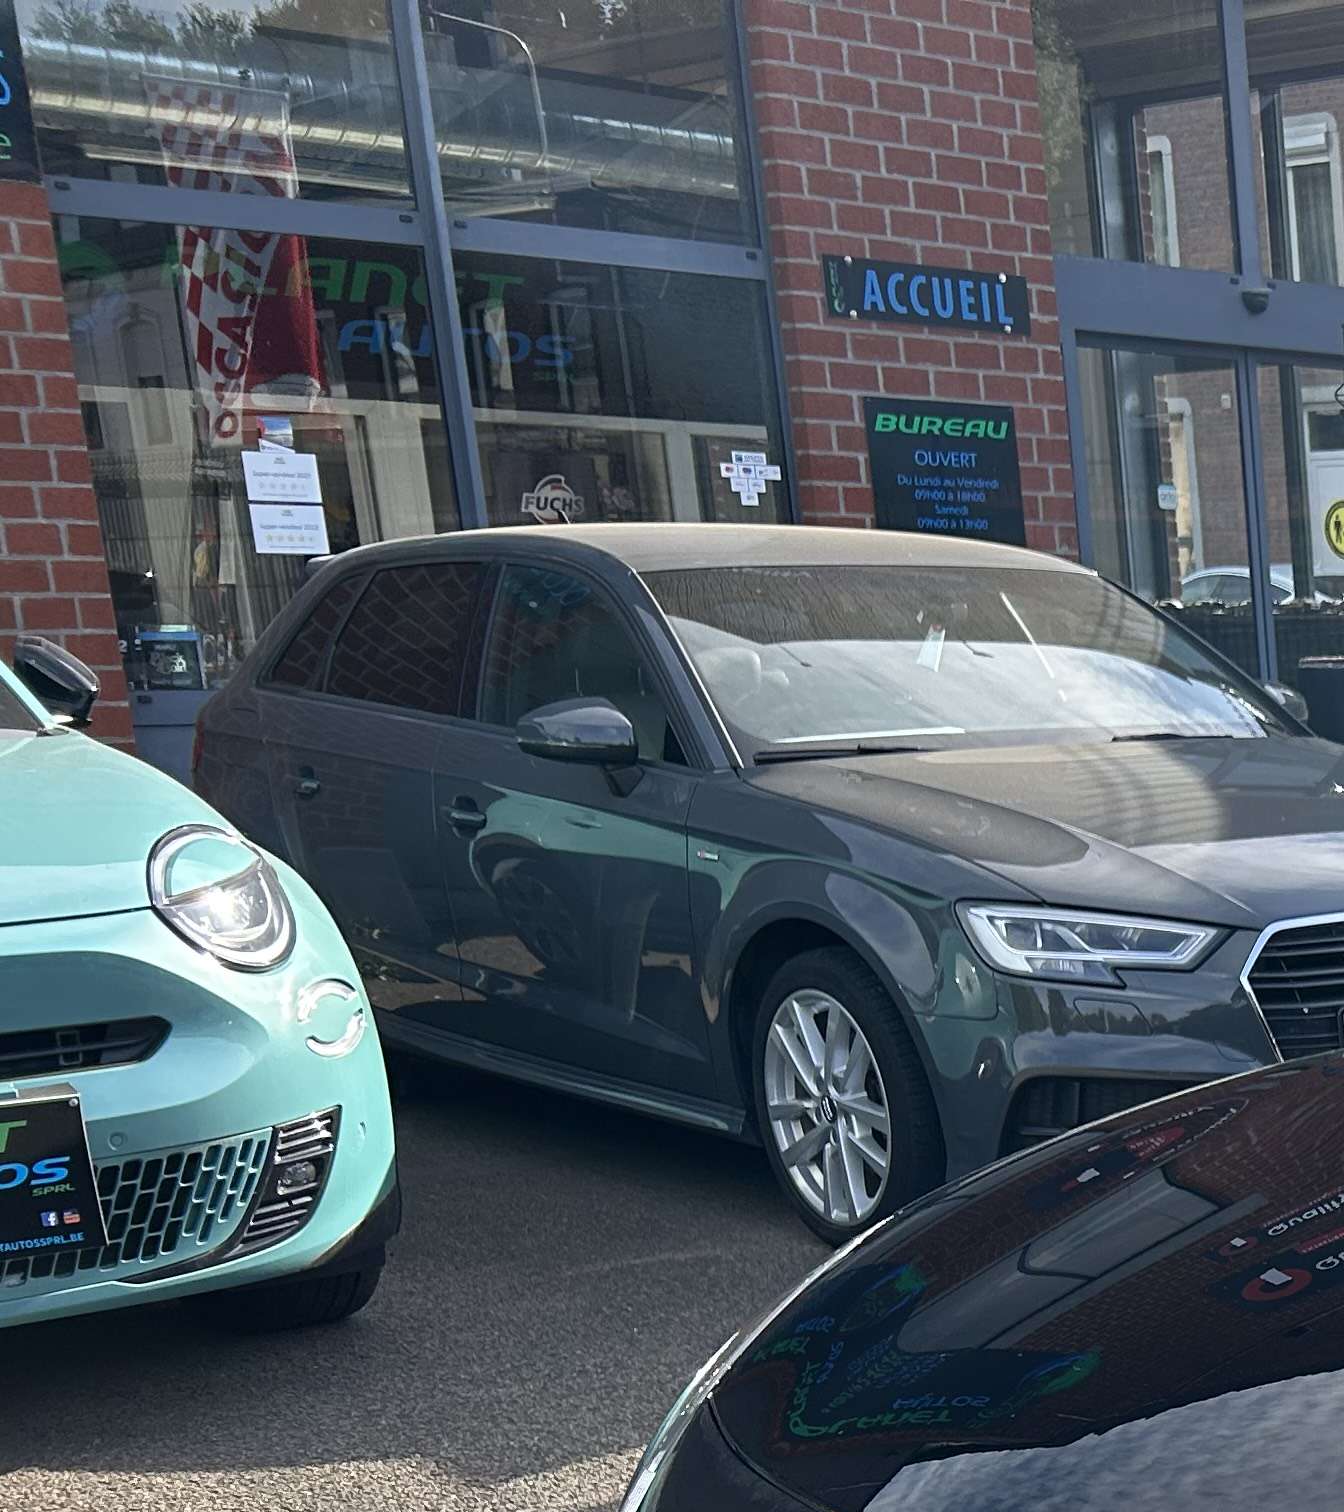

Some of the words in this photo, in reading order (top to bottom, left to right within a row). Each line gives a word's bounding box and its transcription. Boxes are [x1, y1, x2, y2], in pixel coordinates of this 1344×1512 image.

[863, 269, 1014, 325] ACCUEIL
[874, 413, 1009, 440] BUREAU
[914, 450, 978, 468] OUVERT
[897, 474, 912, 486] Du
[914, 475, 942, 487] Lundi
[943, 478, 956, 488] au
[957, 477, 1000, 490] Vendredi
[914, 489, 946, 501] 09h00
[522, 495, 584, 513] FUCHS
[934, 504, 969, 516] Samedi
[917, 517, 949, 529] 09h00
[958, 518, 989, 531] 13h00
[32, 1182, 77, 1197] SPRL
